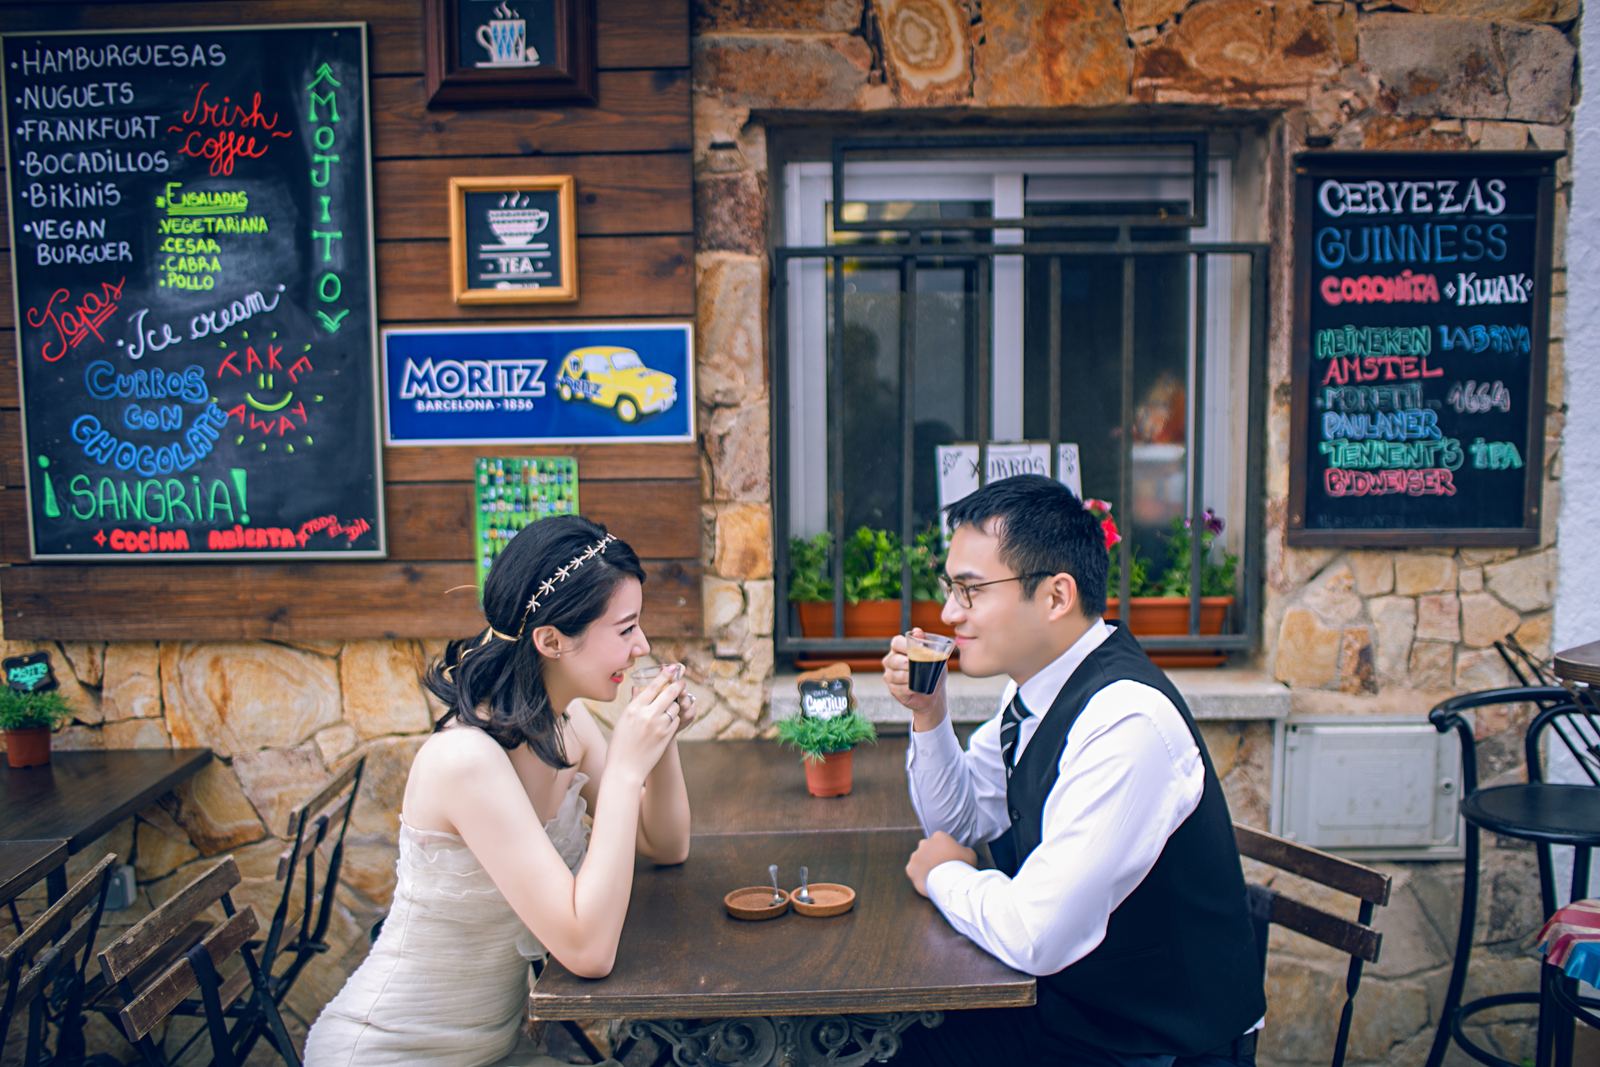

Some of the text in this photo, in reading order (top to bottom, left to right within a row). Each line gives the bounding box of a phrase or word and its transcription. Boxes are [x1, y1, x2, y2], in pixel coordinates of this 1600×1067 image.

[23, 43, 226, 75] HAMBURGUESAS
[23, 82, 135, 110] NUGUETS
[23, 115, 161, 142] FRANKFURT
[307, 90, 344, 303] MOJITO
[1318, 178, 1507, 217] CERVEZAS
[31, 218, 107, 240] VEGAN
[36, 241, 133, 266] BURGUER
[163, 237, 222, 254] CESAR
[1315, 223, 1508, 269] GUINNESS
[166, 256, 222, 273] CABRA
[498, 256, 535, 273] TEA
[167, 272, 215, 291] POLLO
[1455, 272, 1529, 306] KWAK
[27, 276, 126, 363] Tapas
[217, 344, 314, 384] TAKE
[400, 357, 548, 399] MORITZ
[1321, 356, 1444, 385] AMSTEL
[85, 360, 209, 404] CURROS
[124, 403, 183, 432] CON
[228, 401, 309, 437] AWAY
[416, 398, 535, 413] BARCELONA 1856
[1321, 408, 1443, 440] PAULANER
[70, 403, 231, 477] CHOCOLATE
[1323, 467, 1457, 497] BUDWEISER
